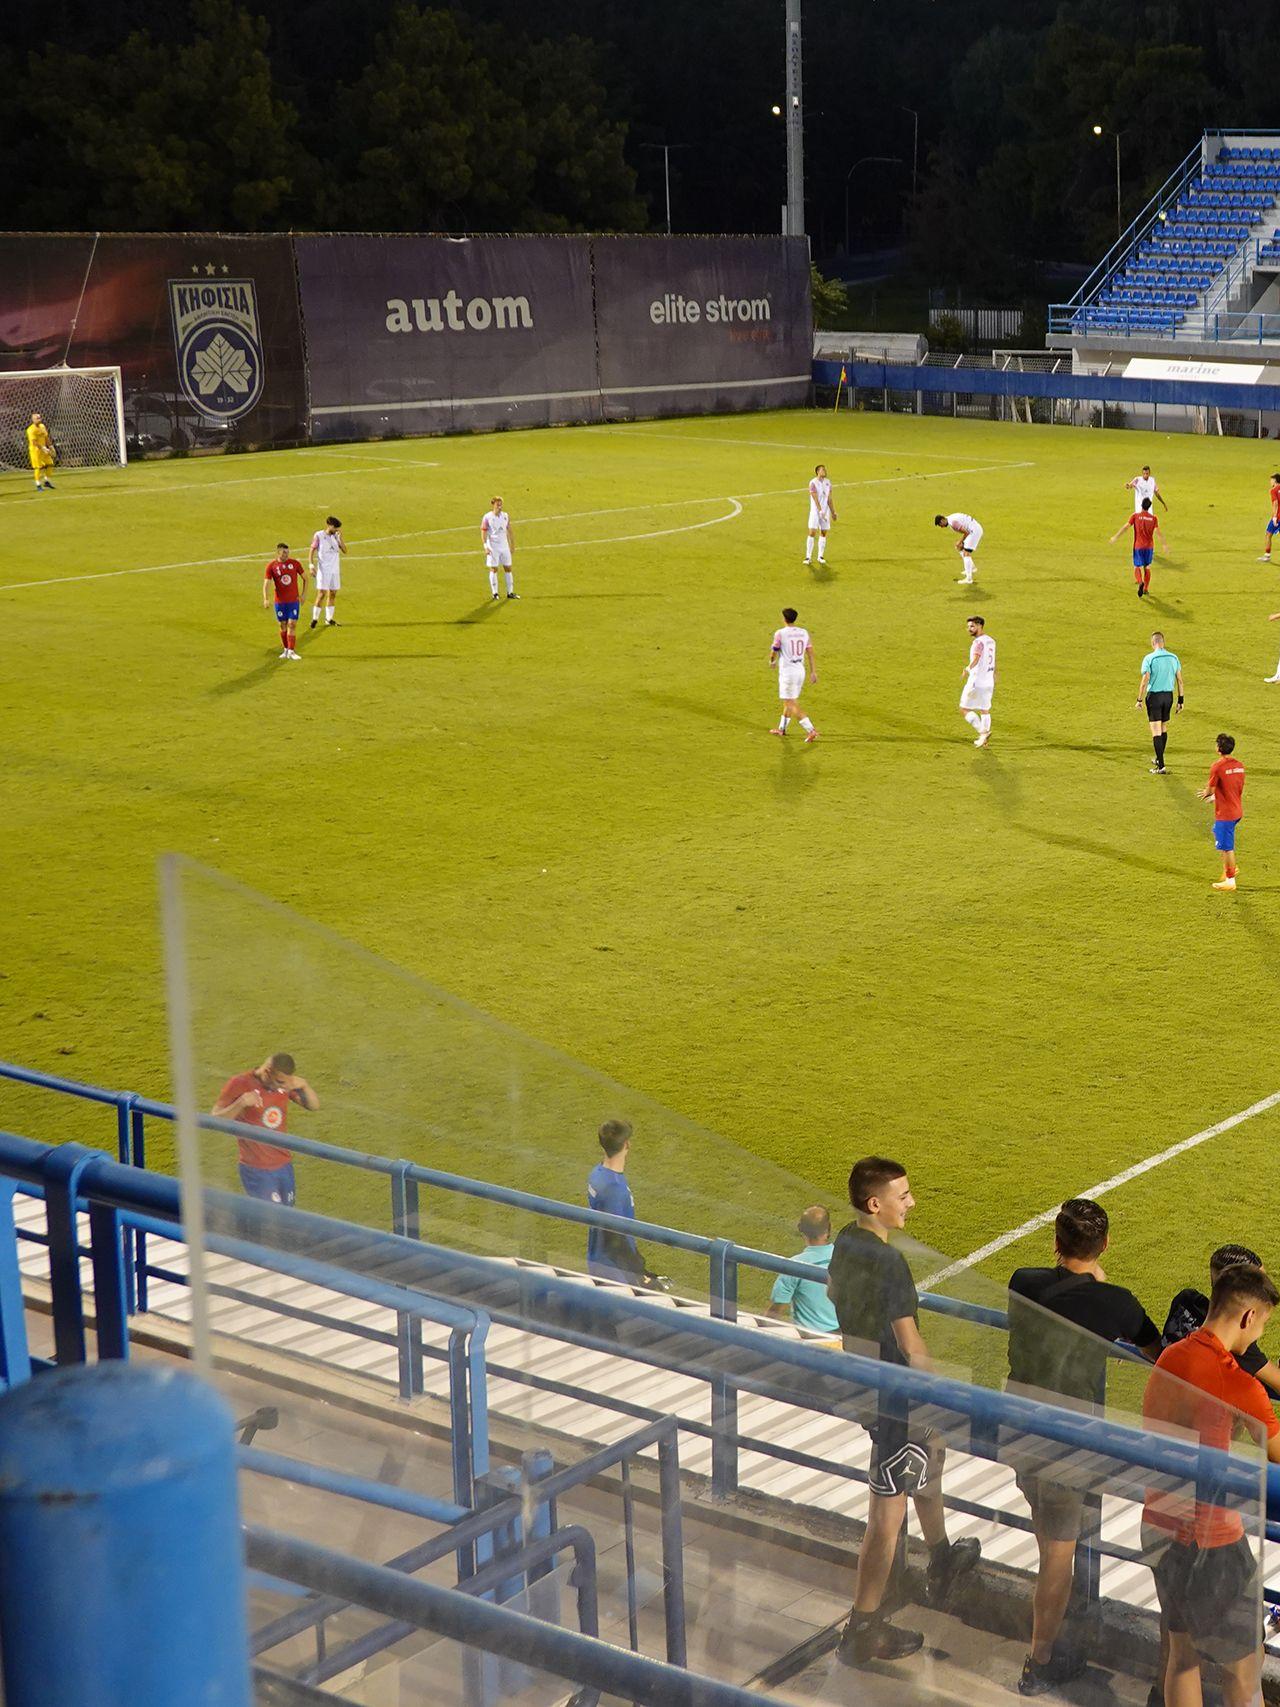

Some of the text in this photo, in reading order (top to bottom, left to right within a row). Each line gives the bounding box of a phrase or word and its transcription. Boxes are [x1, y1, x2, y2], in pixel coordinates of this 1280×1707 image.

[177, 287, 250, 318] ΚΗΦΙΣΙΑ
[385, 290, 534, 333] autom
[649, 293, 771, 324] elite strom
[790, 639, 804, 656] 10
